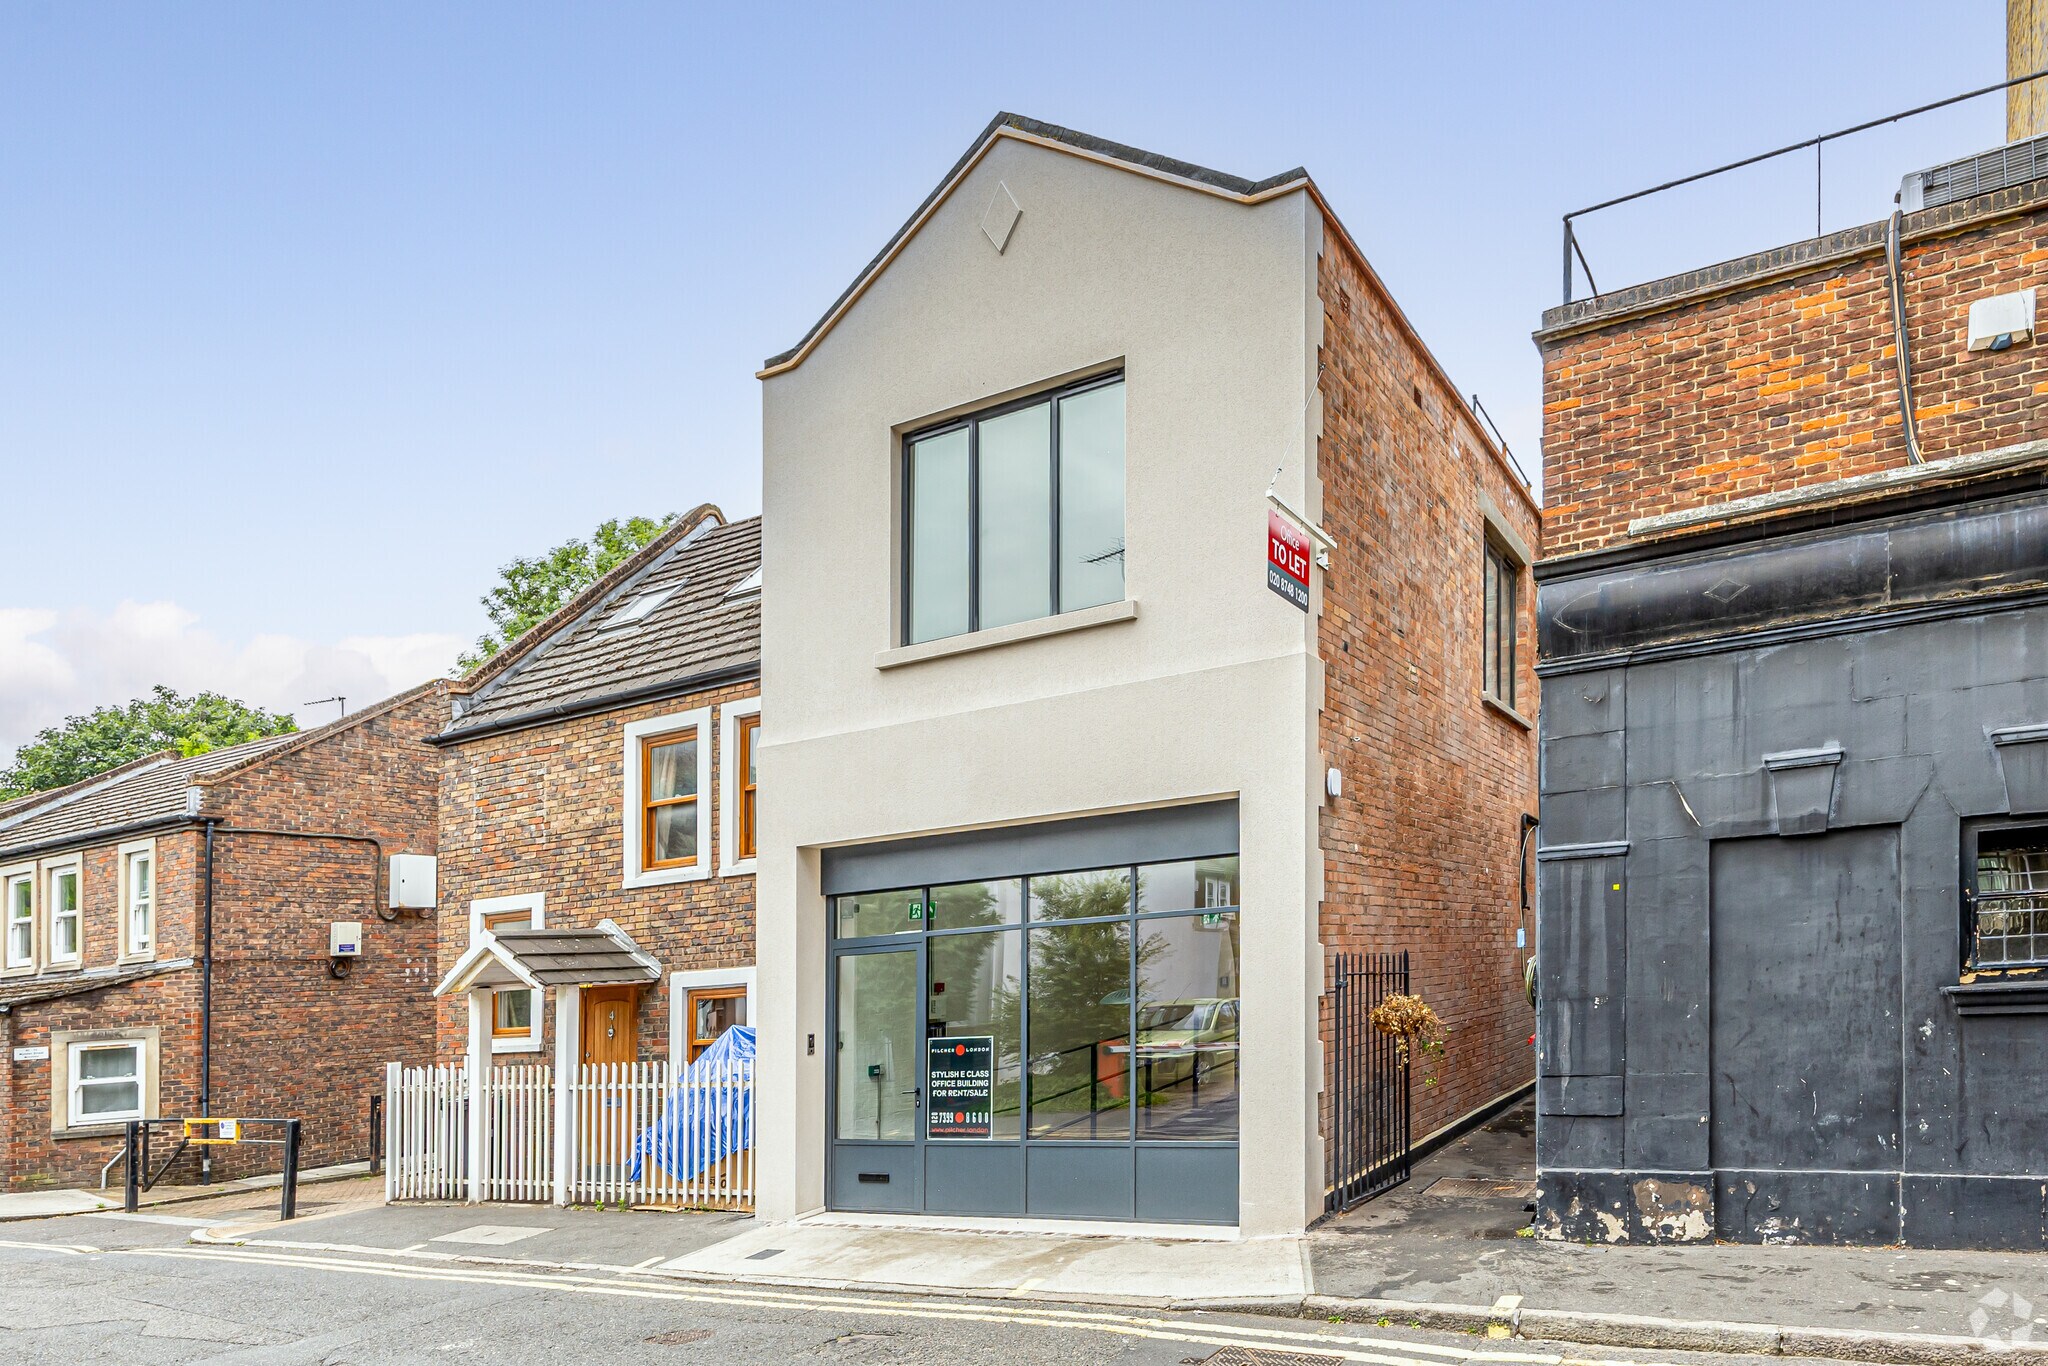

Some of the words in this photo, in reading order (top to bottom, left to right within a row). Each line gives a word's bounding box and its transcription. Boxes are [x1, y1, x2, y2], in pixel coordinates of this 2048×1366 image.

[1281, 525, 1300, 551] Office
[1272, 537, 1287, 565] TO
[1289, 550, 1307, 579] LET
[1269, 569, 1280, 588] 020
[1295, 587, 1308, 606] 1200
[609, 1010, 614, 1021] 4
[931, 1070, 960, 1079] STYLISH
[960, 1070, 966, 1078] E
[966, 1070, 989, 1078] CLASS
[931, 1080, 956, 1088] OFFICE
[957, 1079, 989, 1087] BUILDING
[932, 1089, 947, 1097] FOR
[948, 1089, 989, 1097] RENT/SALE
[938, 1111, 954, 1124] 7399
[965, 1111, 989, 1124] 8600
